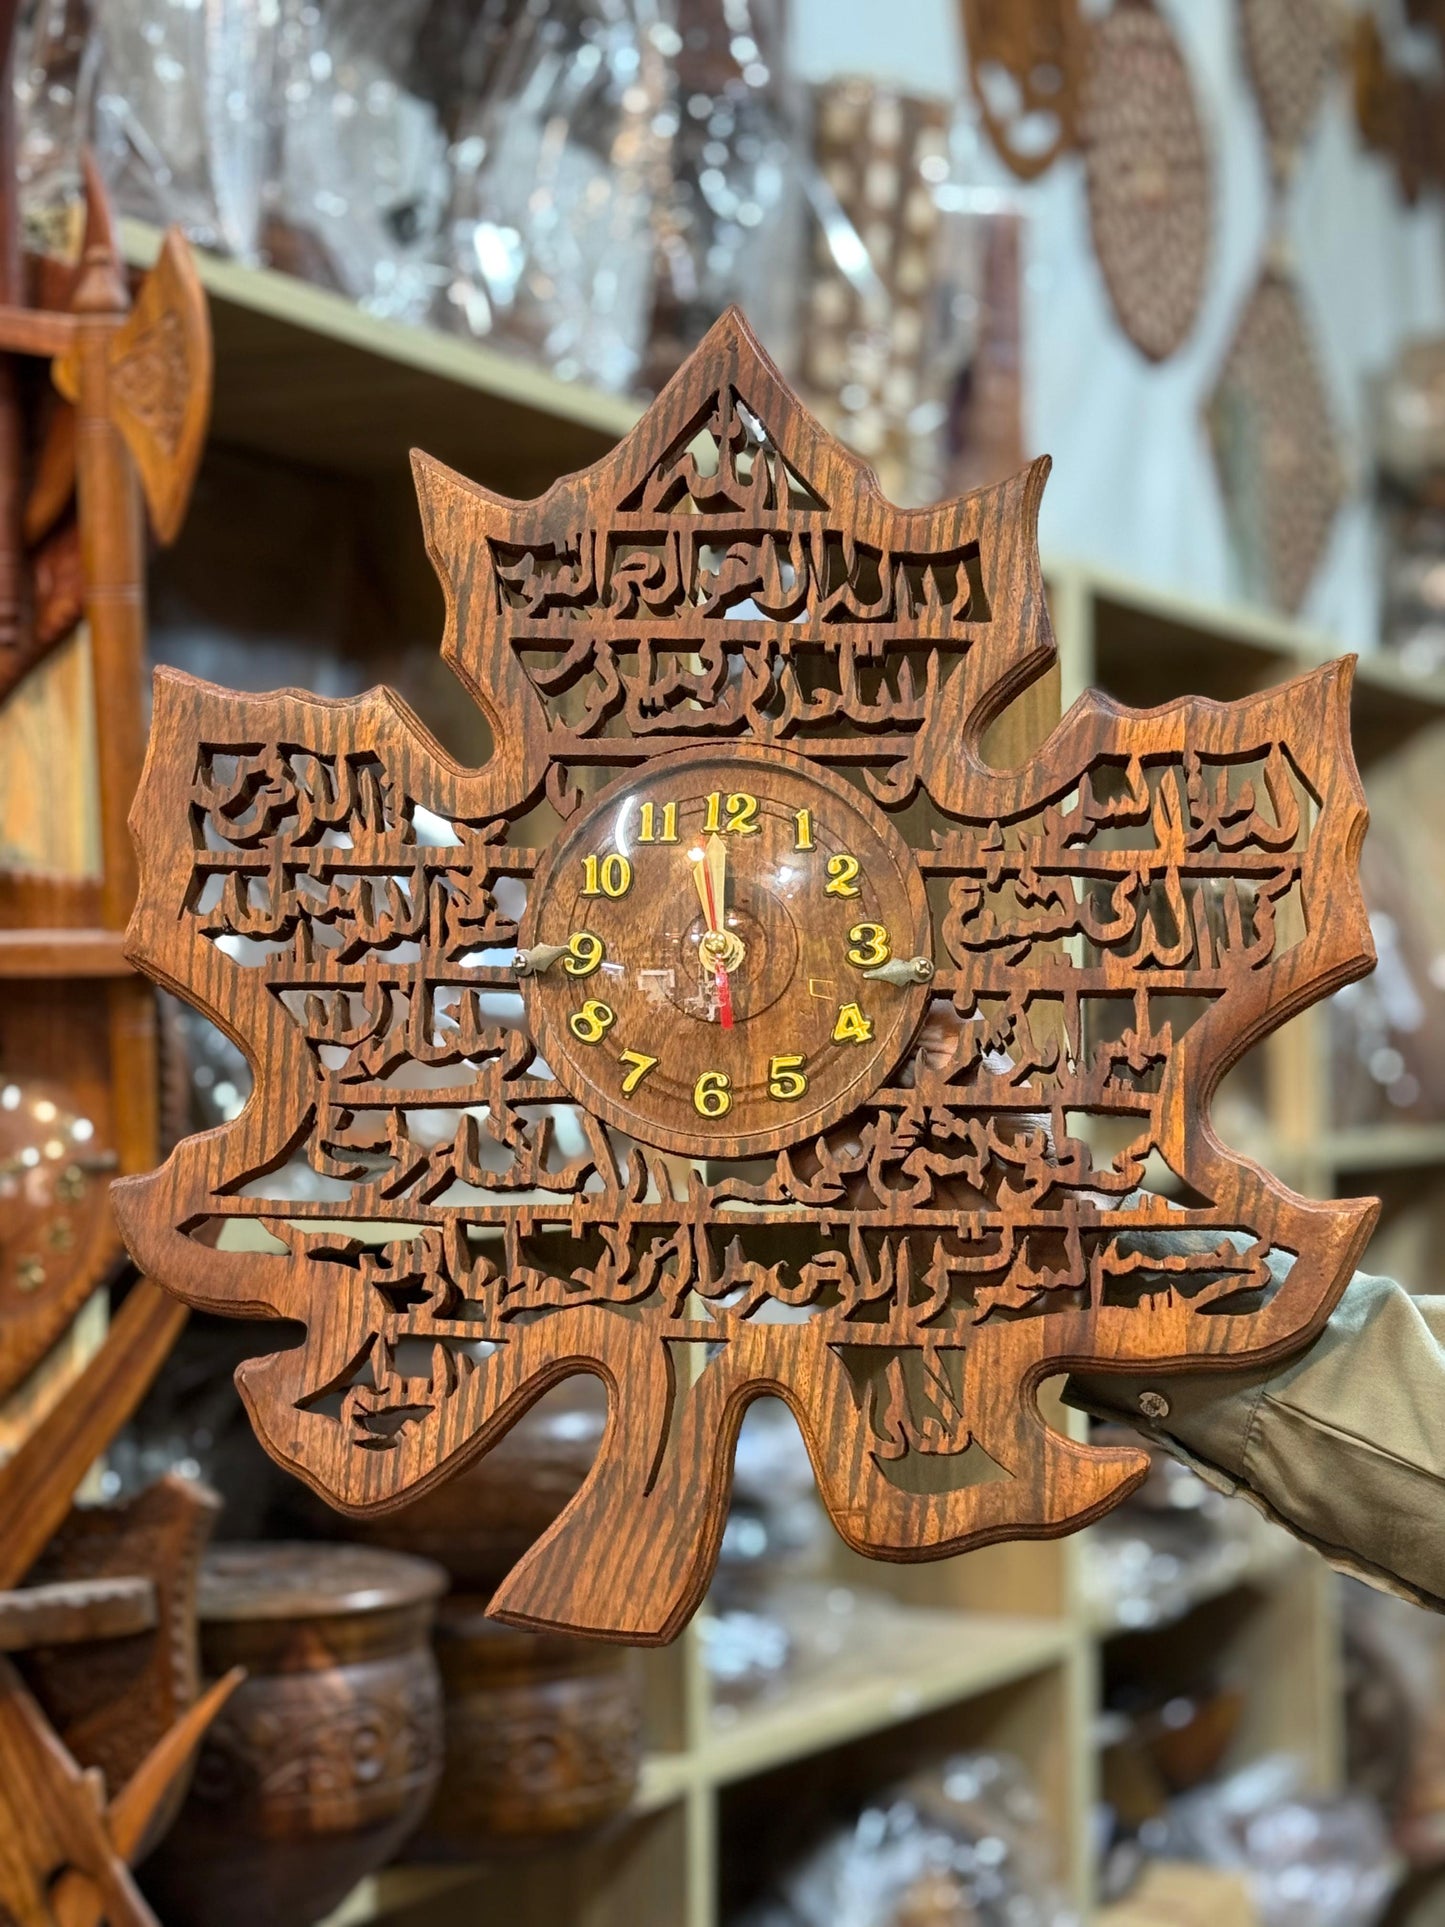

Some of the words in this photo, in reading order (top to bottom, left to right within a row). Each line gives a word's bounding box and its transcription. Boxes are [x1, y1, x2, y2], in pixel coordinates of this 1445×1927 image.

[638, 802, 680, 845] 11
[701, 791, 761, 835] 12
[794, 809, 816, 851] 1
[582, 854, 633, 900] 10
[824, 853, 861, 898] 2
[564, 931, 604, 977] 9
[847, 923, 892, 969] 3
[569, 998, 618, 1045] 8
[831, 1002, 875, 1045] 4
[619, 1048, 659, 1098] 7
[694, 1071, 733, 1120] 6
[768, 1053, 808, 1100] 5
